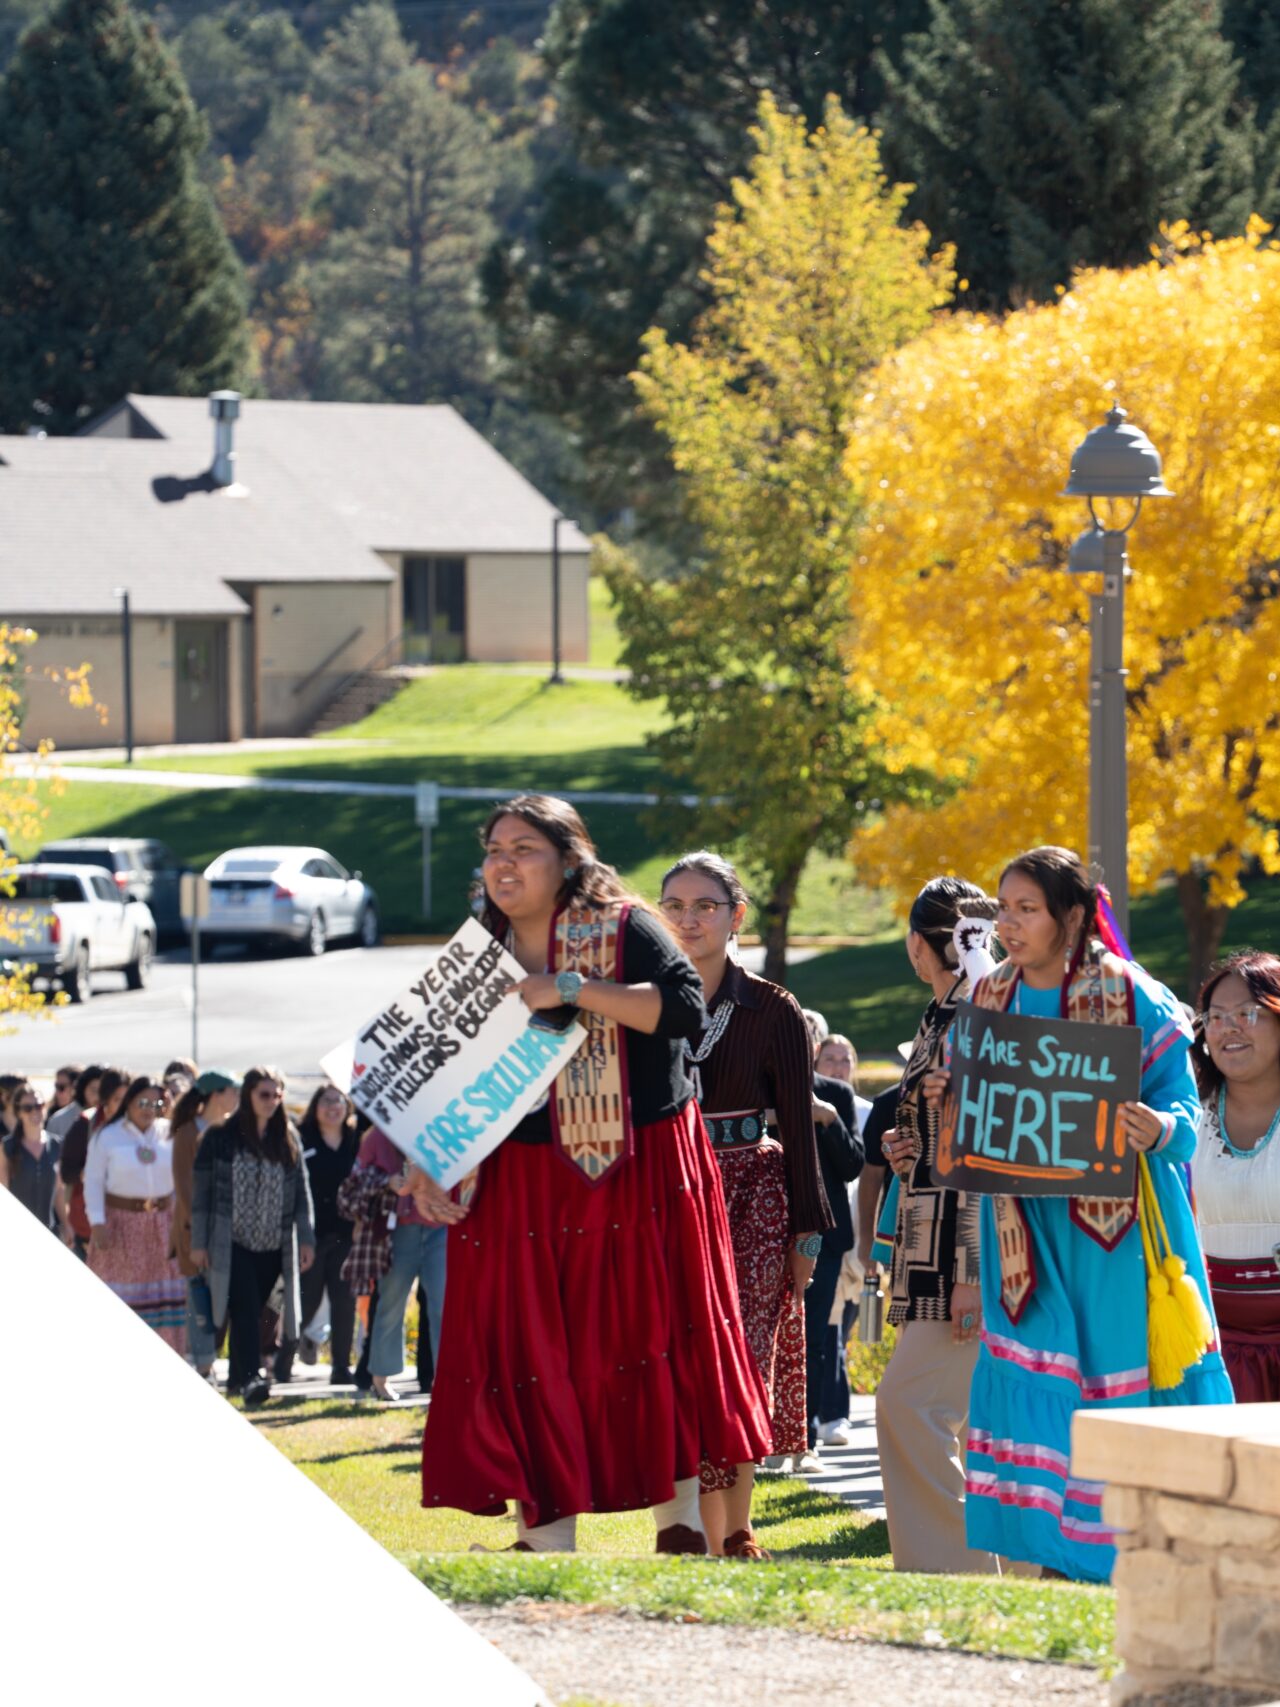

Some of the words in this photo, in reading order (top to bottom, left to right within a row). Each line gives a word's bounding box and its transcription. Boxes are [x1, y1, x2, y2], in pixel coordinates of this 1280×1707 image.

[350, 1023, 435, 1110] INDIGENOUS
[427, 938, 505, 1031] GENOCIDE
[361, 1003, 413, 1051] THE
[409, 940, 475, 1006] YEAR
[455, 967, 517, 1039] BEGAN
[957, 1015, 972, 1059] WE
[978, 1026, 1022, 1066] ARE
[1029, 1035, 1117, 1082] STILL
[426, 1097, 485, 1163] ARE
